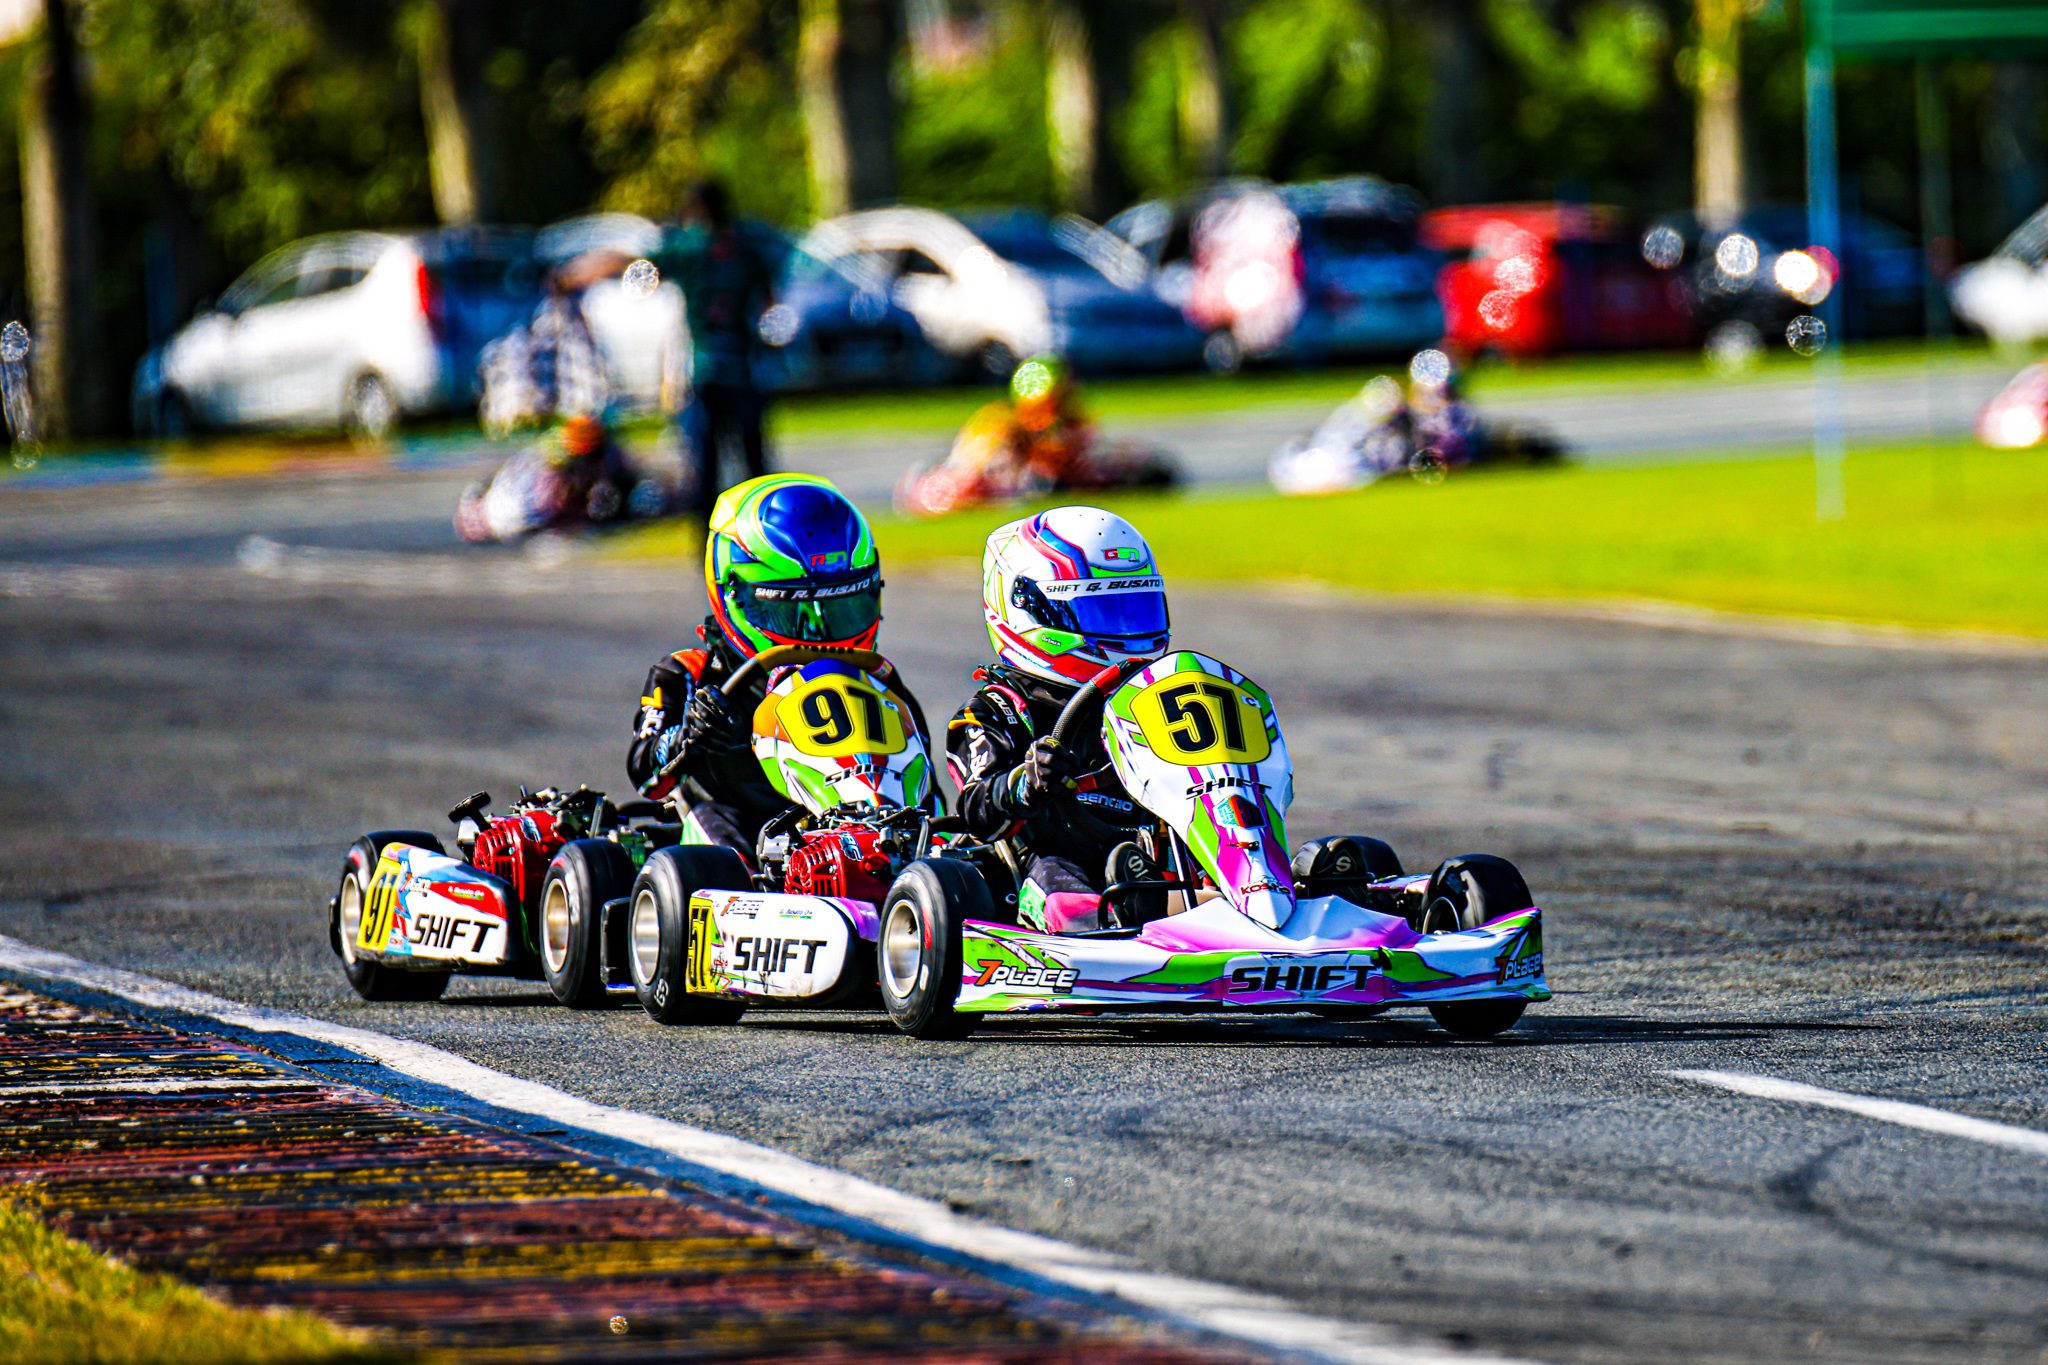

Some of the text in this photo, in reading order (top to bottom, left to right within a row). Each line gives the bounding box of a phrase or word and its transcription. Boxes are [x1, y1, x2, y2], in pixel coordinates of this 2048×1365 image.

[755, 587, 787, 599] SHIFT
[814, 579, 870, 598] BUSATO
[1046, 584, 1080, 593] SHIFT
[1107, 579, 1160, 589] BUSATO
[802, 684, 887, 746] 97
[1156, 682, 1247, 753] 57
[1186, 777, 1272, 800] SHIFT
[409, 913, 500, 953] SHIFT
[733, 937, 828, 974] SHIFT
[1228, 965, 1377, 993] SHIFT
